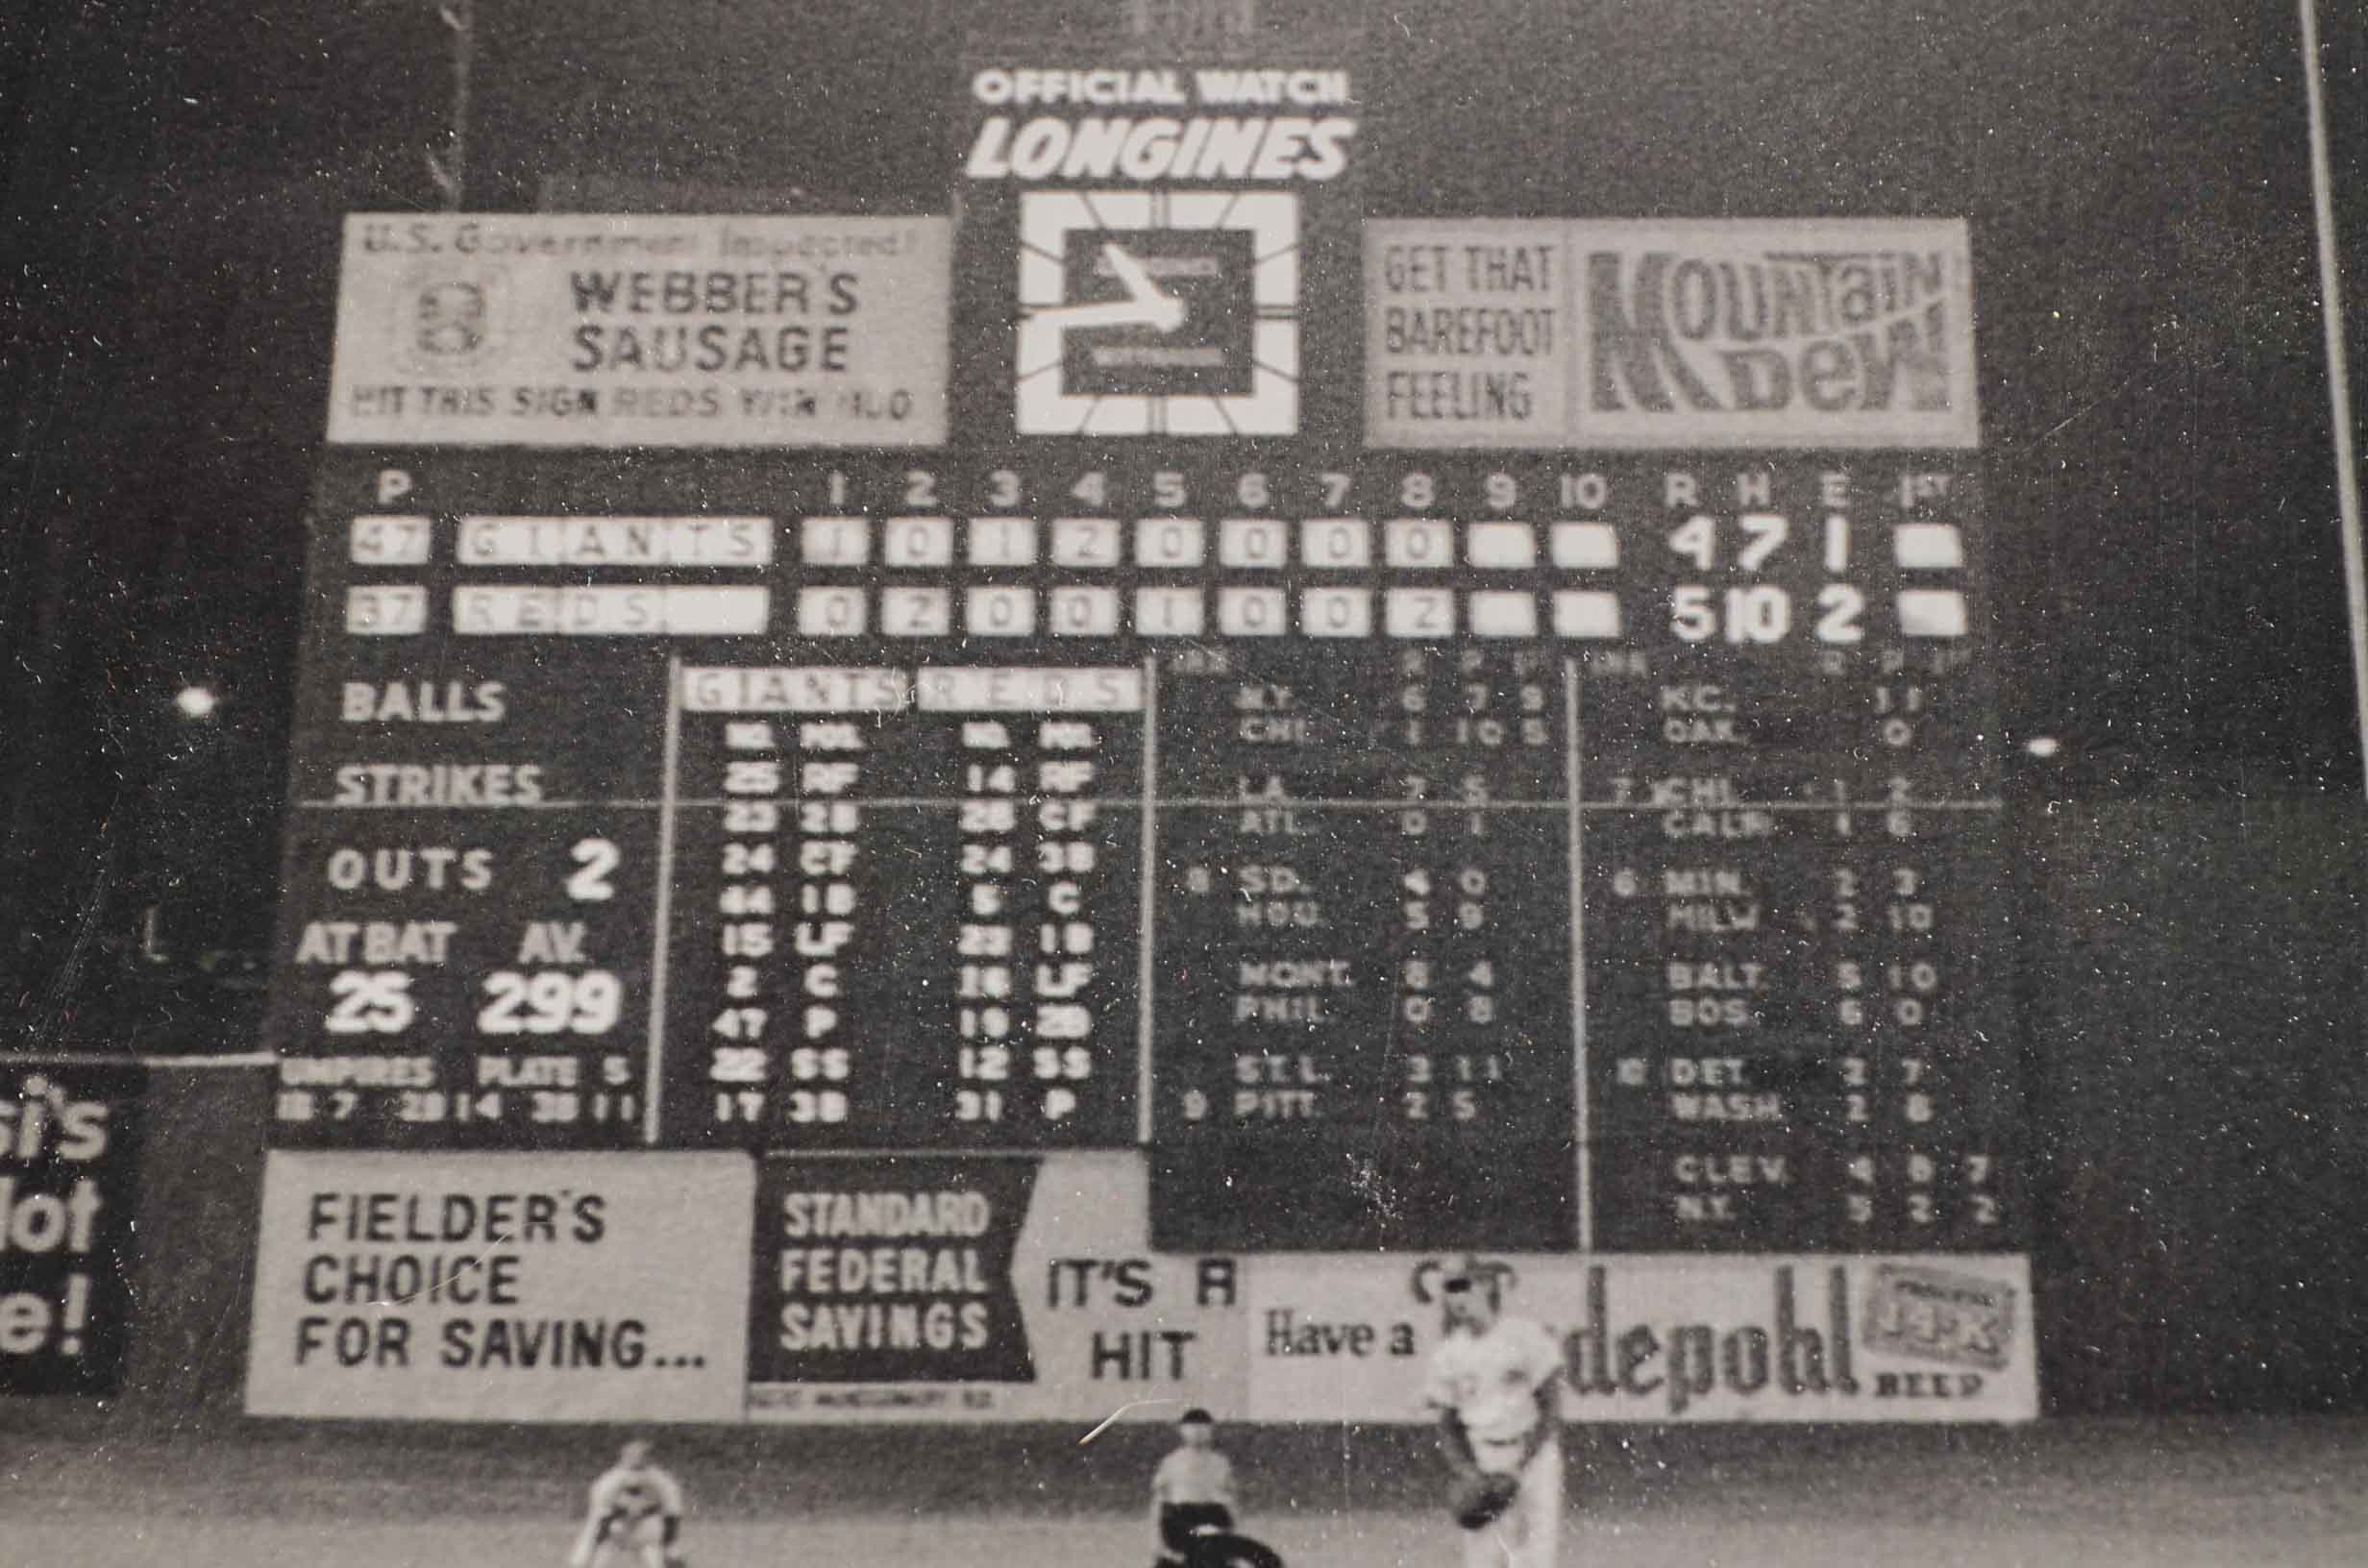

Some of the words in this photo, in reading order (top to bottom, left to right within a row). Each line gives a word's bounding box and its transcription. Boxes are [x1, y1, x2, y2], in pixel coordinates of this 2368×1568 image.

[974, 70, 1185, 104] OFFICIAL
[1196, 70, 1349, 104] WATCH
[966, 117, 1358, 181] LONGINES
[1385, 245, 1448, 291] GET
[1464, 245, 1555, 292] THAT
[572, 326, 849, 373] SAUSAGE
[1385, 306, 1556, 356] BAREFOOT
[613, 387, 721, 421] REDS
[1385, 370, 1532, 420] FEELING
[378, 469, 412, 504] P
[829, 471, 847, 506] 1
[904, 470, 938, 507] 2
[990, 469, 1021, 507] 3
[1072, 472, 1106, 506] 4
[1153, 471, 1187, 508] 5
[1237, 472, 1270, 508] 6
[1320, 472, 1351, 508] 7
[1400, 472, 1435, 510] 8
[1485, 472, 1517, 511] 9
[1560, 472, 1609, 510] 10
[1665, 472, 1698, 507] R
[1736, 473, 1770, 505] H
[1820, 472, 1849, 508] E
[471, 524, 756, 558] GIANTS
[907, 526, 929, 558] 0
[999, 525, 1011, 557] 1
[1077, 525, 1107, 558] 2
[1162, 526, 1184, 559] 0
[1245, 526, 1268, 560] 0
[1328, 526, 1351, 560] 0
[1406, 525, 1430, 560] 0
[1668, 515, 1716, 571] 4
[1739, 513, 1788, 572] 7
[1824, 514, 1849, 572] 1
[468, 593, 650, 628] REDS
[827, 595, 851, 629] 0
[989, 595, 1012, 629] 0
[1068, 595, 1092, 628] 0
[1162, 595, 1175, 628] 1
[1243, 595, 1266, 629] 0
[1327, 595, 1351, 629] 0
[1670, 585, 1716, 643] 5
[1725, 584, 1791, 644] 10
[1816, 583, 1864, 644] 2
[342, 681, 506, 723] BALLS
[696, 672, 900, 707] GIANTS
[931, 672, 1122, 707] REDS
[1456, 719, 1505, 747] 10
[1883, 718, 1912, 747] 0
[334, 765, 544, 805] STRIKES
[328, 846, 492, 892] OUTS
[566, 838, 620, 901] 2
[1048, 881, 1080, 916] C
[294, 918, 358, 965] AT
[364, 918, 457, 965] BAT
[325, 970, 416, 1034] 25
[478, 970, 622, 1035] 299
[712, 1007, 768, 1039] 47
[715, 1090, 765, 1122] 17
[306, 1189, 607, 1243] FIELDER'S
[782, 1191, 992, 1237] STANDARD
[302, 1254, 521, 1305] CHOICE
[778, 1248, 988, 1293] FEDERAL
[1048, 1257, 1154, 1307] IT'S
[1196, 1259, 1236, 1305] A
[295, 1316, 411, 1366] FOR
[441, 1317, 707, 1369] SAVING...
[777, 1301, 989, 1349] SAVINGS
[1265, 1308, 1374, 1358] Have
[1390, 1320, 1415, 1356] a
[1091, 1330, 1197, 1381] HIT
